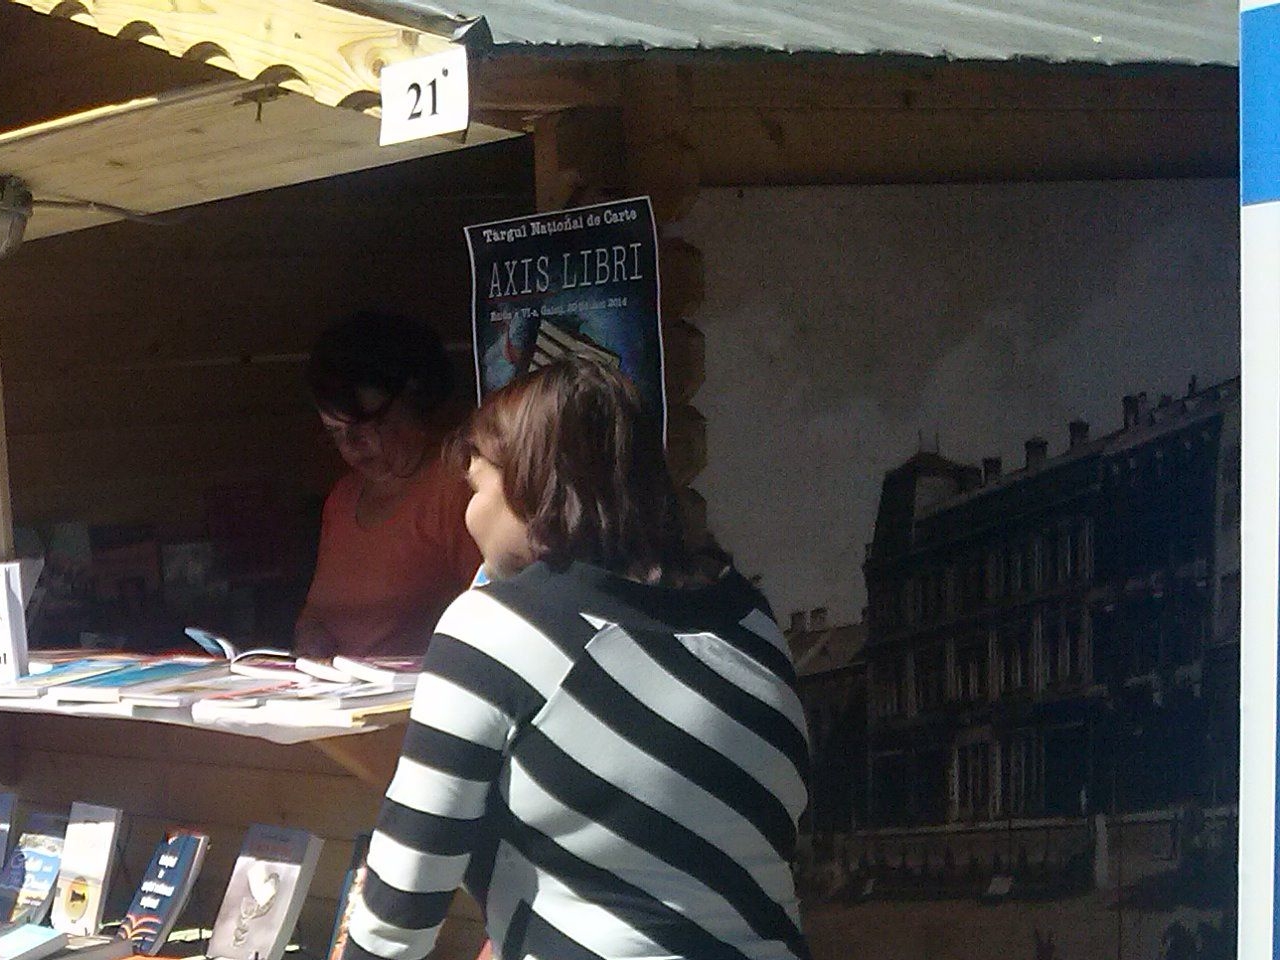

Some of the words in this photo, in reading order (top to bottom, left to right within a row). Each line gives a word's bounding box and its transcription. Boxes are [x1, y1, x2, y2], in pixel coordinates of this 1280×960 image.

[406, 77, 439, 121] 21
[587, 213, 600, 226] de
[603, 207, 638, 225] Carte
[488, 255, 550, 299] AXIS
[561, 242, 644, 290] LIBRI
